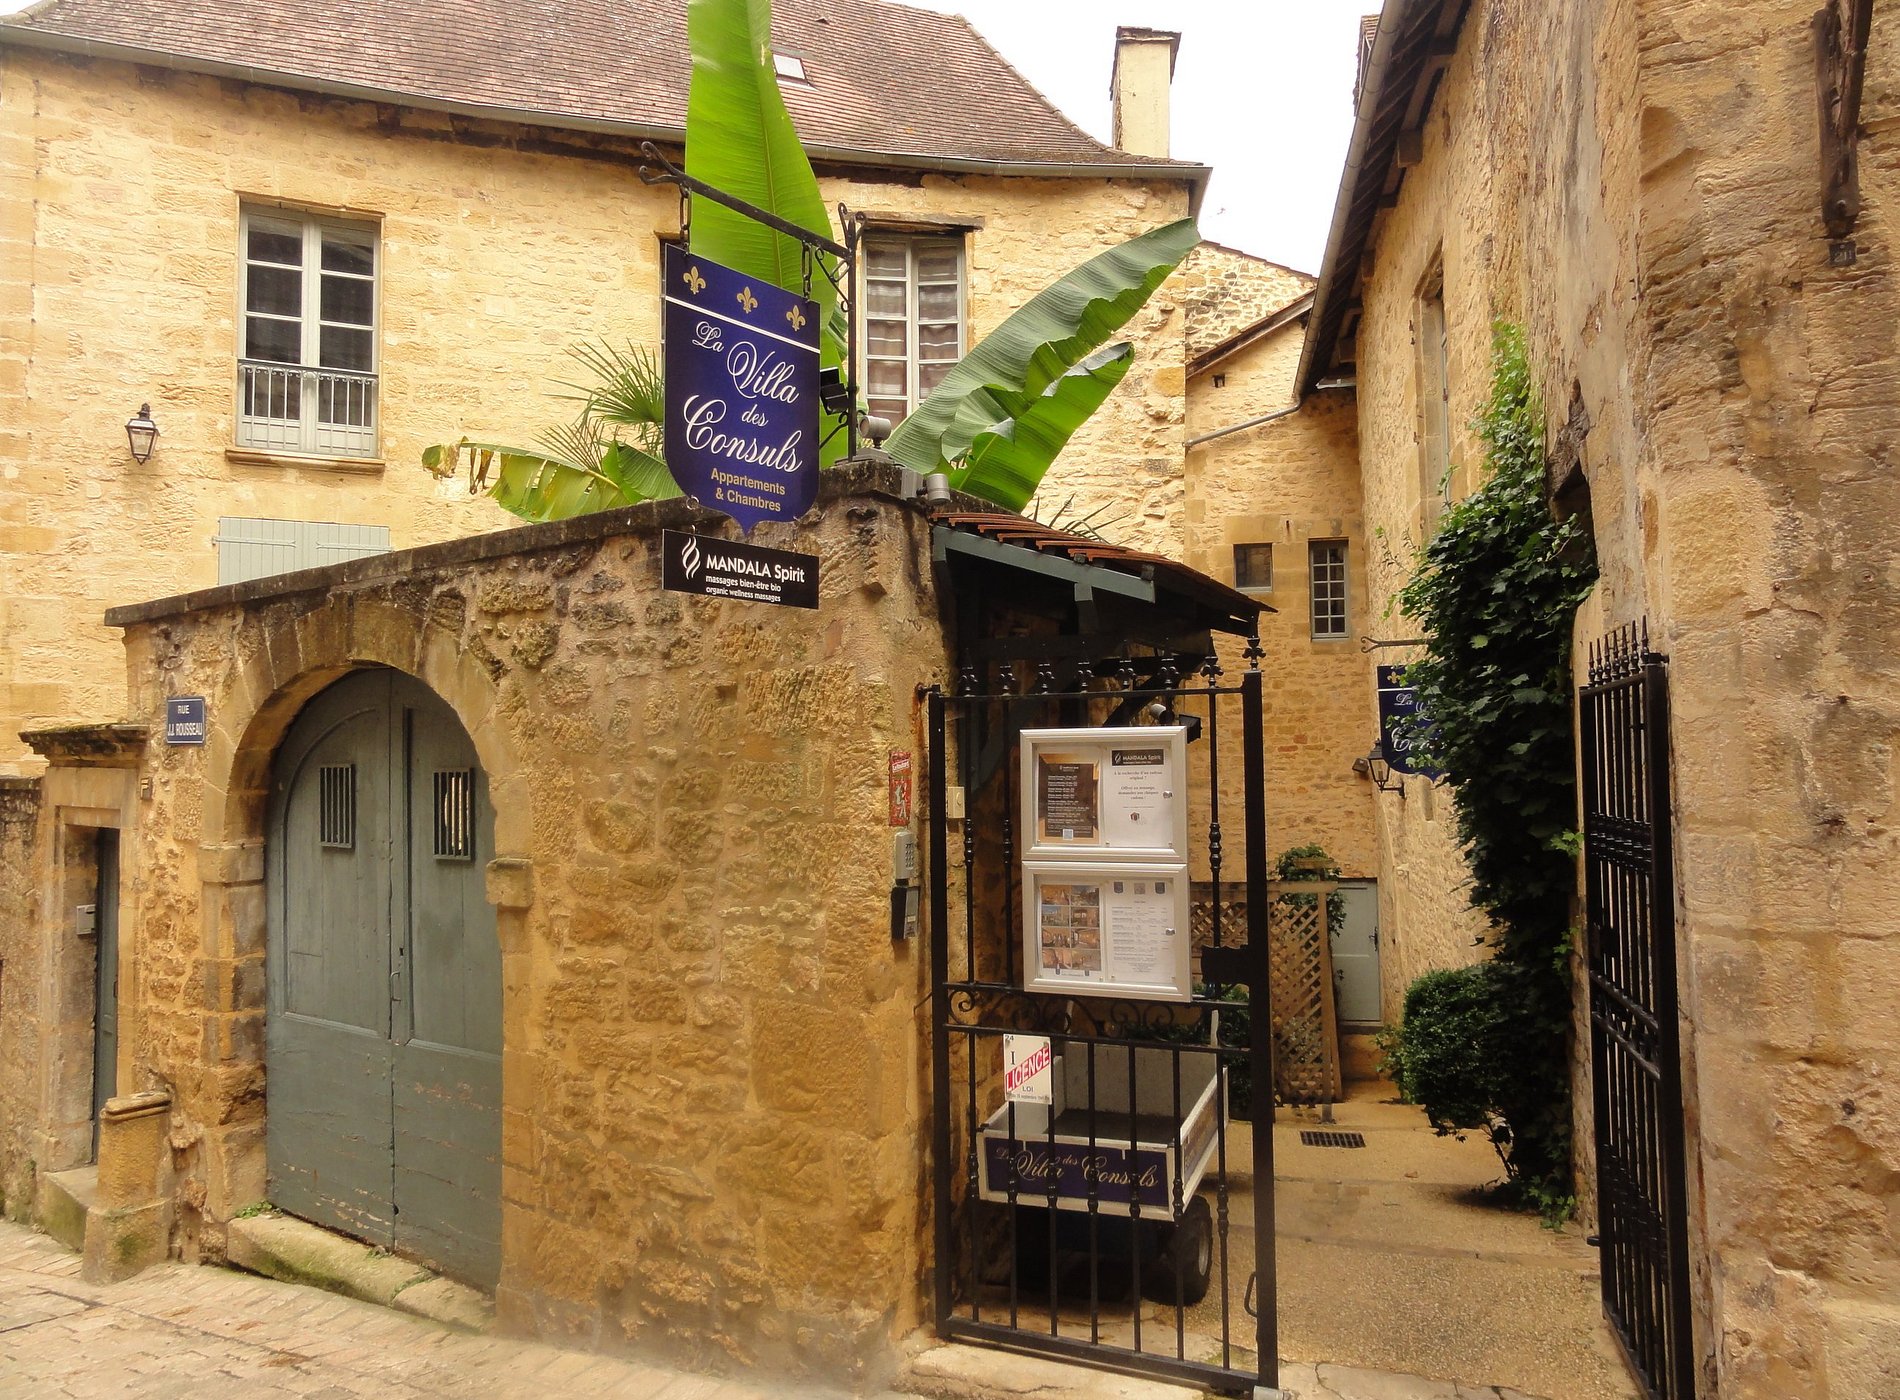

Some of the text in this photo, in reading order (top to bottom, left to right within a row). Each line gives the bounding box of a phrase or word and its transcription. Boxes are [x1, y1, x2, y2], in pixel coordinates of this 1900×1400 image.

[691, 320, 724, 353] La
[726, 340, 800, 404] Villa
[741, 403, 769, 427] des
[683, 394, 803, 473] Consuls
[710, 467, 786, 496] Appartements
[715, 487, 781, 512] & Chambres
[706, 553, 805, 583] MANDALA Spirit
[705, 575, 782, 592] massages bien-être bio
[705, 586, 781, 603] organic wellness massages
[177, 704, 190, 715] RUE
[175, 722, 203, 736] ROUSSEAU
[1006, 1047, 1050, 1093] LICENCE
[1010, 1051, 1016, 1065] I
[1062, 1153, 1078, 1166] des
[1081, 1155, 1158, 1187] Consls
